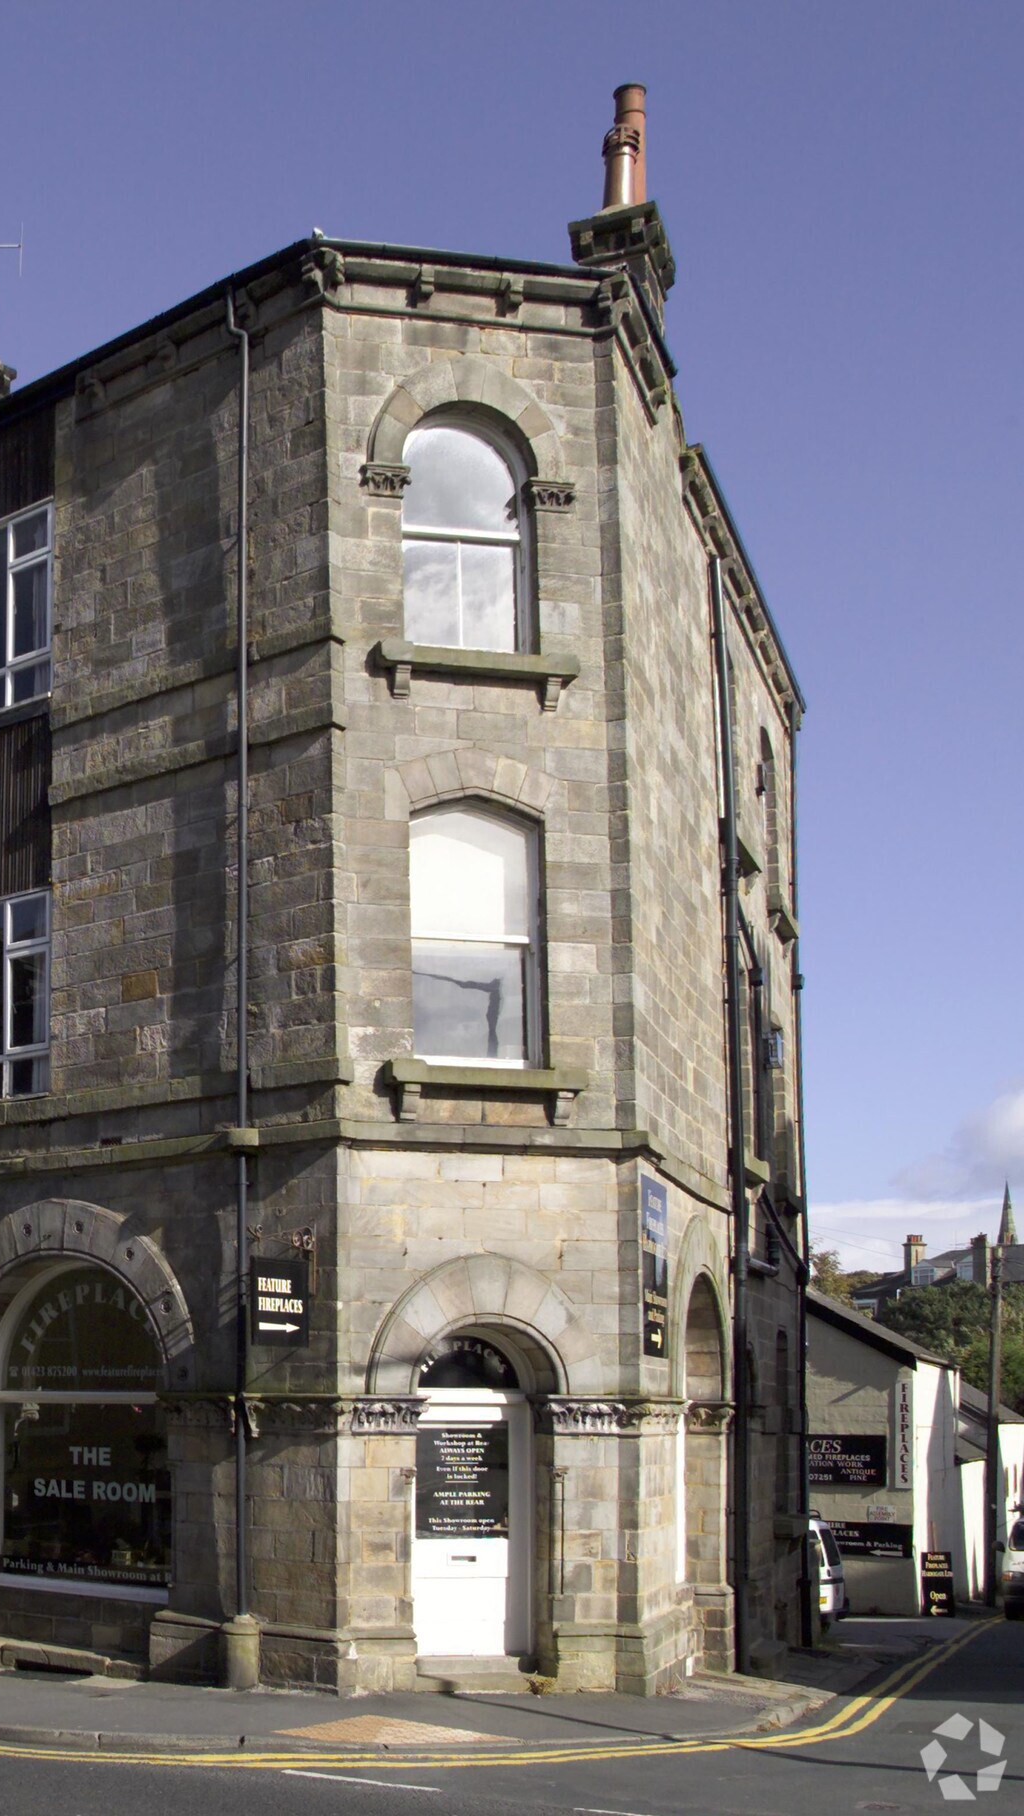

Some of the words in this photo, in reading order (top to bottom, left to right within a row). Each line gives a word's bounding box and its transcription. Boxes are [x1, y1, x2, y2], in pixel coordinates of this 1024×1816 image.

[258, 1277, 292, 1294] FEATURE
[258, 1296, 303, 1314] FIREPLACES
[899, 1383, 910, 1484] FIREPLACES
[69, 1446, 112, 1466] THE
[34, 1478, 86, 1500] SALE
[92, 1481, 156, 1503] ROOM
[432, 1525, 457, 1533] Tuesday
[462, 1526, 490, 1534] Saturday
[873, 1541, 903, 1550] Parking
[2, 1557, 44, 1574] Parking
[46, 1562, 55, 1571] &
[58, 1562, 85, 1575] Main
[87, 1565, 147, 1581] Showroom
[150, 1573, 162, 1582] at
[929, 1590, 947, 1601] Open
